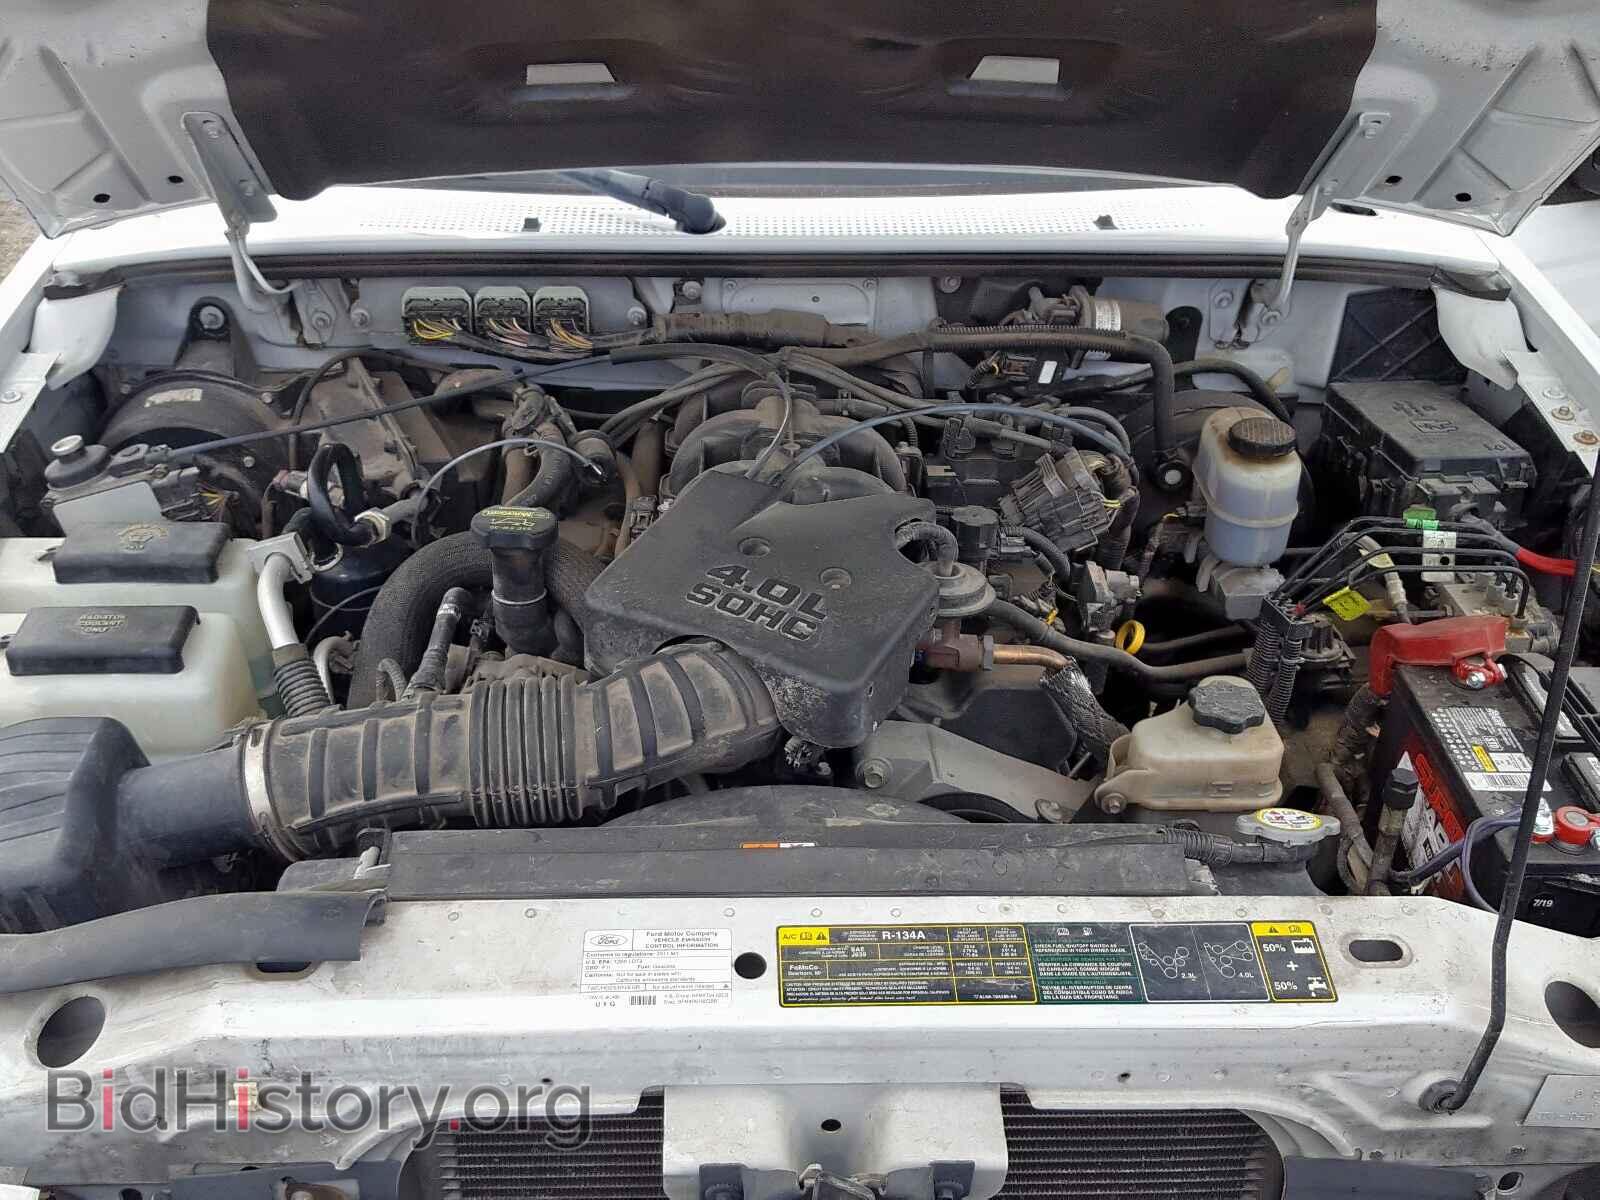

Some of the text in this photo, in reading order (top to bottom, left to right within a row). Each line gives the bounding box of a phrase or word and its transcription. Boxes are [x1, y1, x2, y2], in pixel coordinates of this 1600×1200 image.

[705, 564, 828, 621] 4.0L
[684, 582, 818, 642] SOHC
[596, 934, 620, 946] Ford
[881, 930, 926, 940] R-134A
[1262, 943, 1287, 952] 50%
[1274, 981, 1298, 991] 50%
